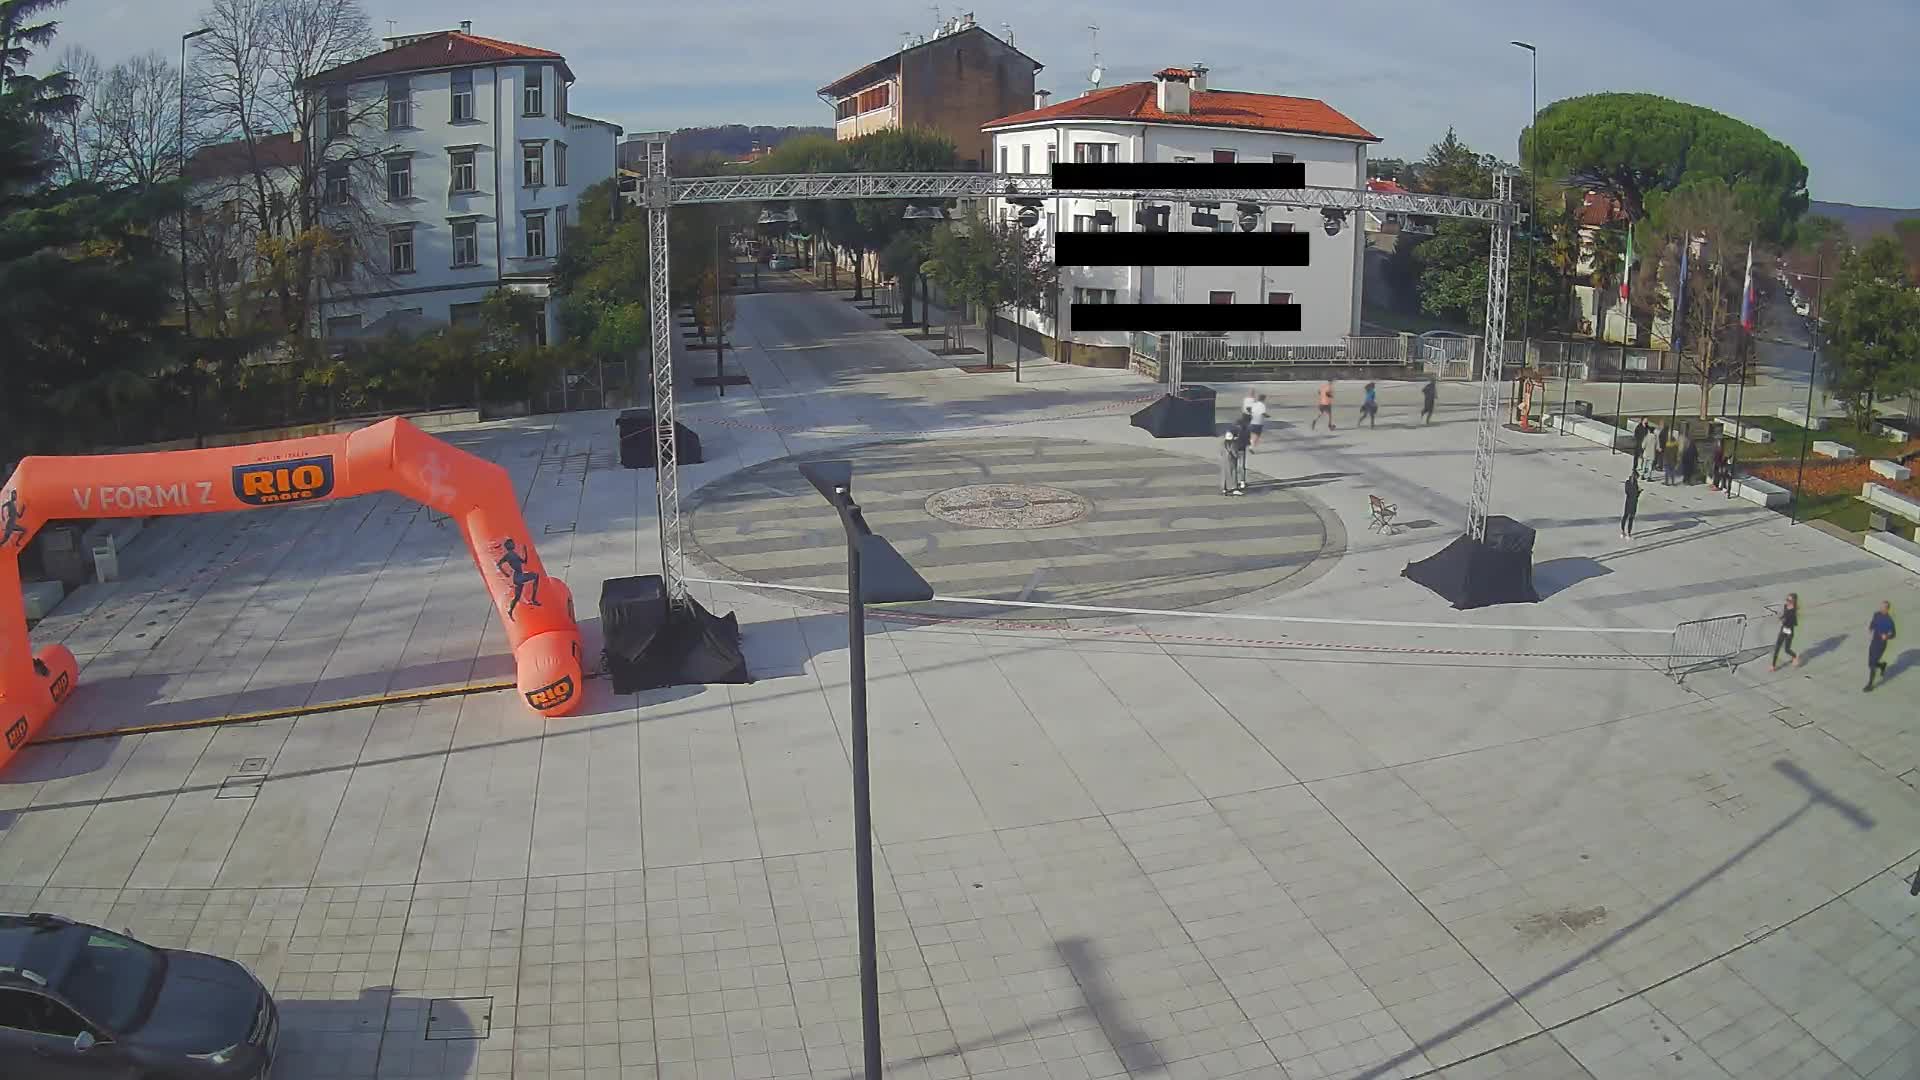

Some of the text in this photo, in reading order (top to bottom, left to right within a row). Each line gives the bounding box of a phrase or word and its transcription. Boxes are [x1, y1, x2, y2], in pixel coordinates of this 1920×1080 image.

[243, 465, 325, 496] RIO
[73, 487, 92, 511] V
[196, 481, 217, 505] Z
[530, 682, 570, 705] RIO
